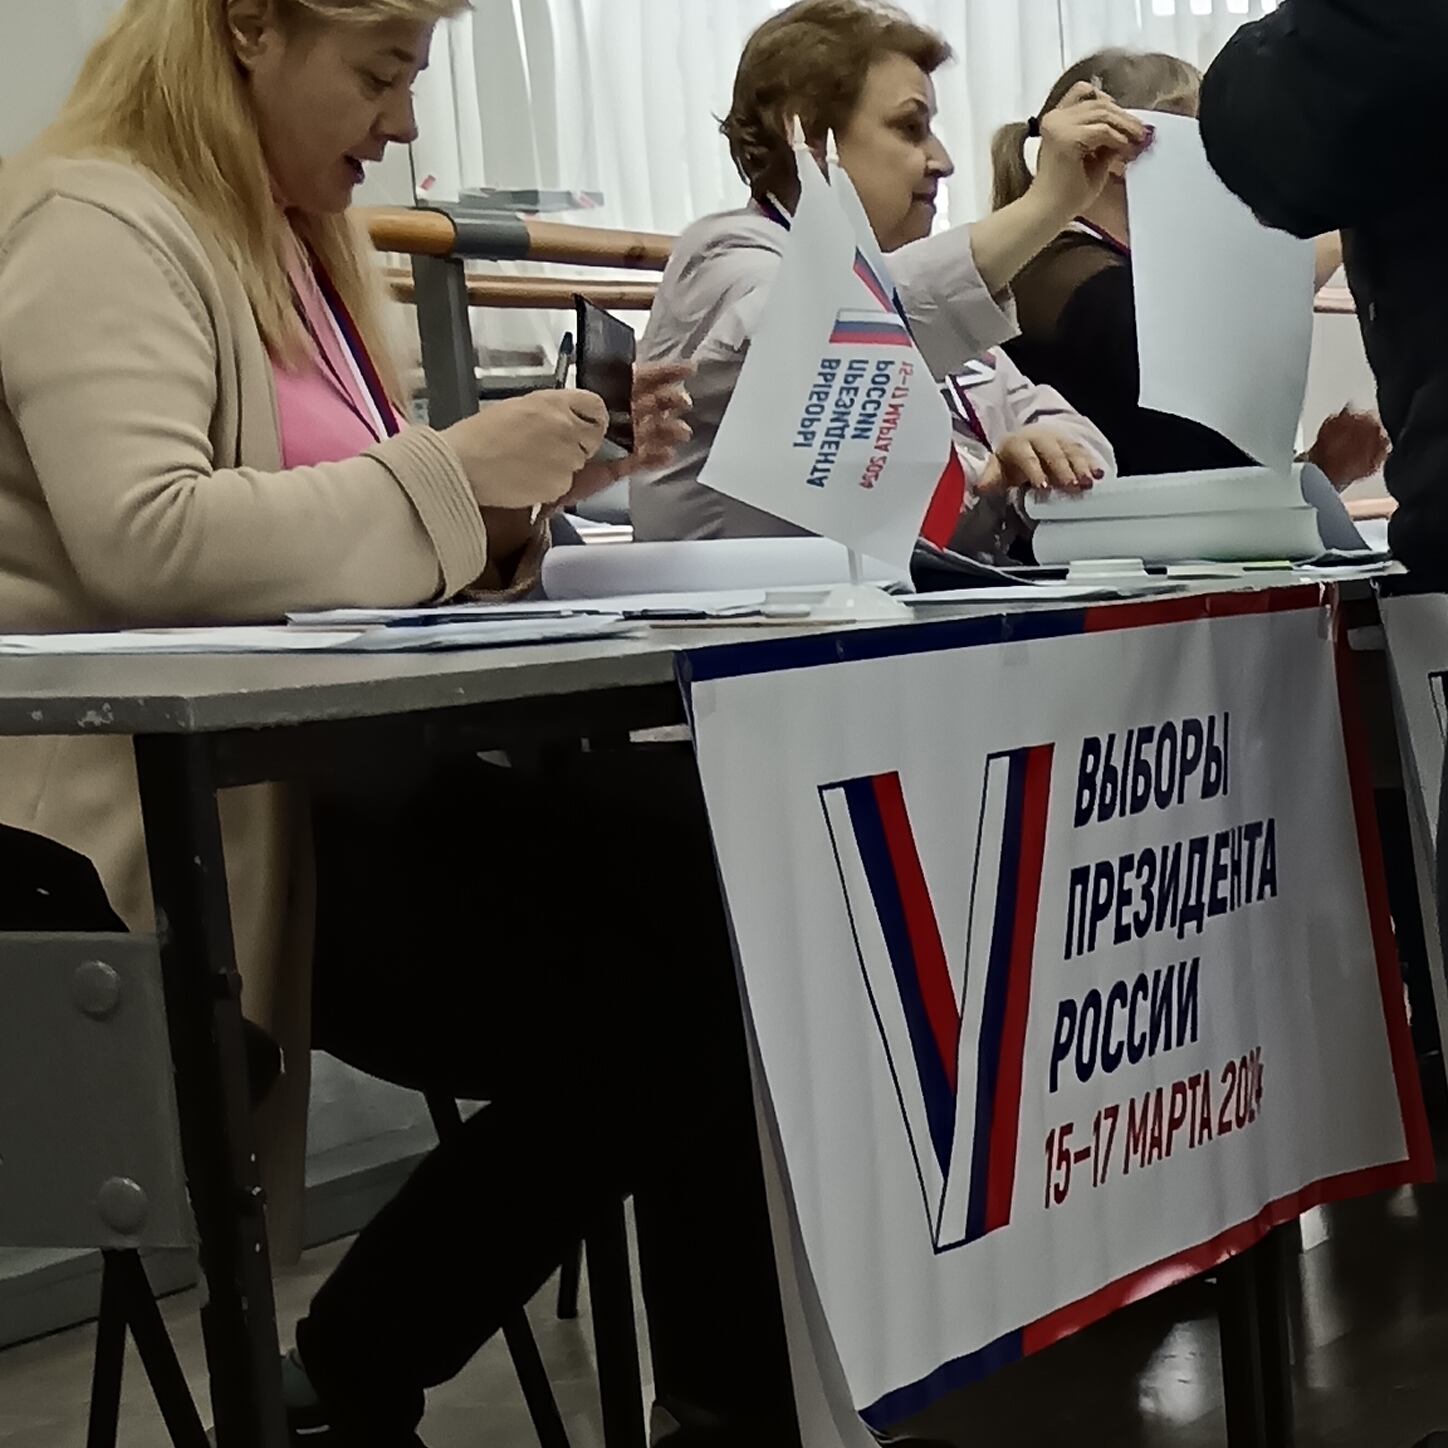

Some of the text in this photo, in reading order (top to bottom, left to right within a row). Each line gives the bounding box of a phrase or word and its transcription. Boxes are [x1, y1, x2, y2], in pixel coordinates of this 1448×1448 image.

[1073, 712, 1229, 828] ВЫБОРЫ
[1064, 818, 1277, 960] ПРЕЗИДЕНТА
[1049, 956, 1200, 1093] РОССИИ
[1123, 1069, 1213, 1175] МАРТА
